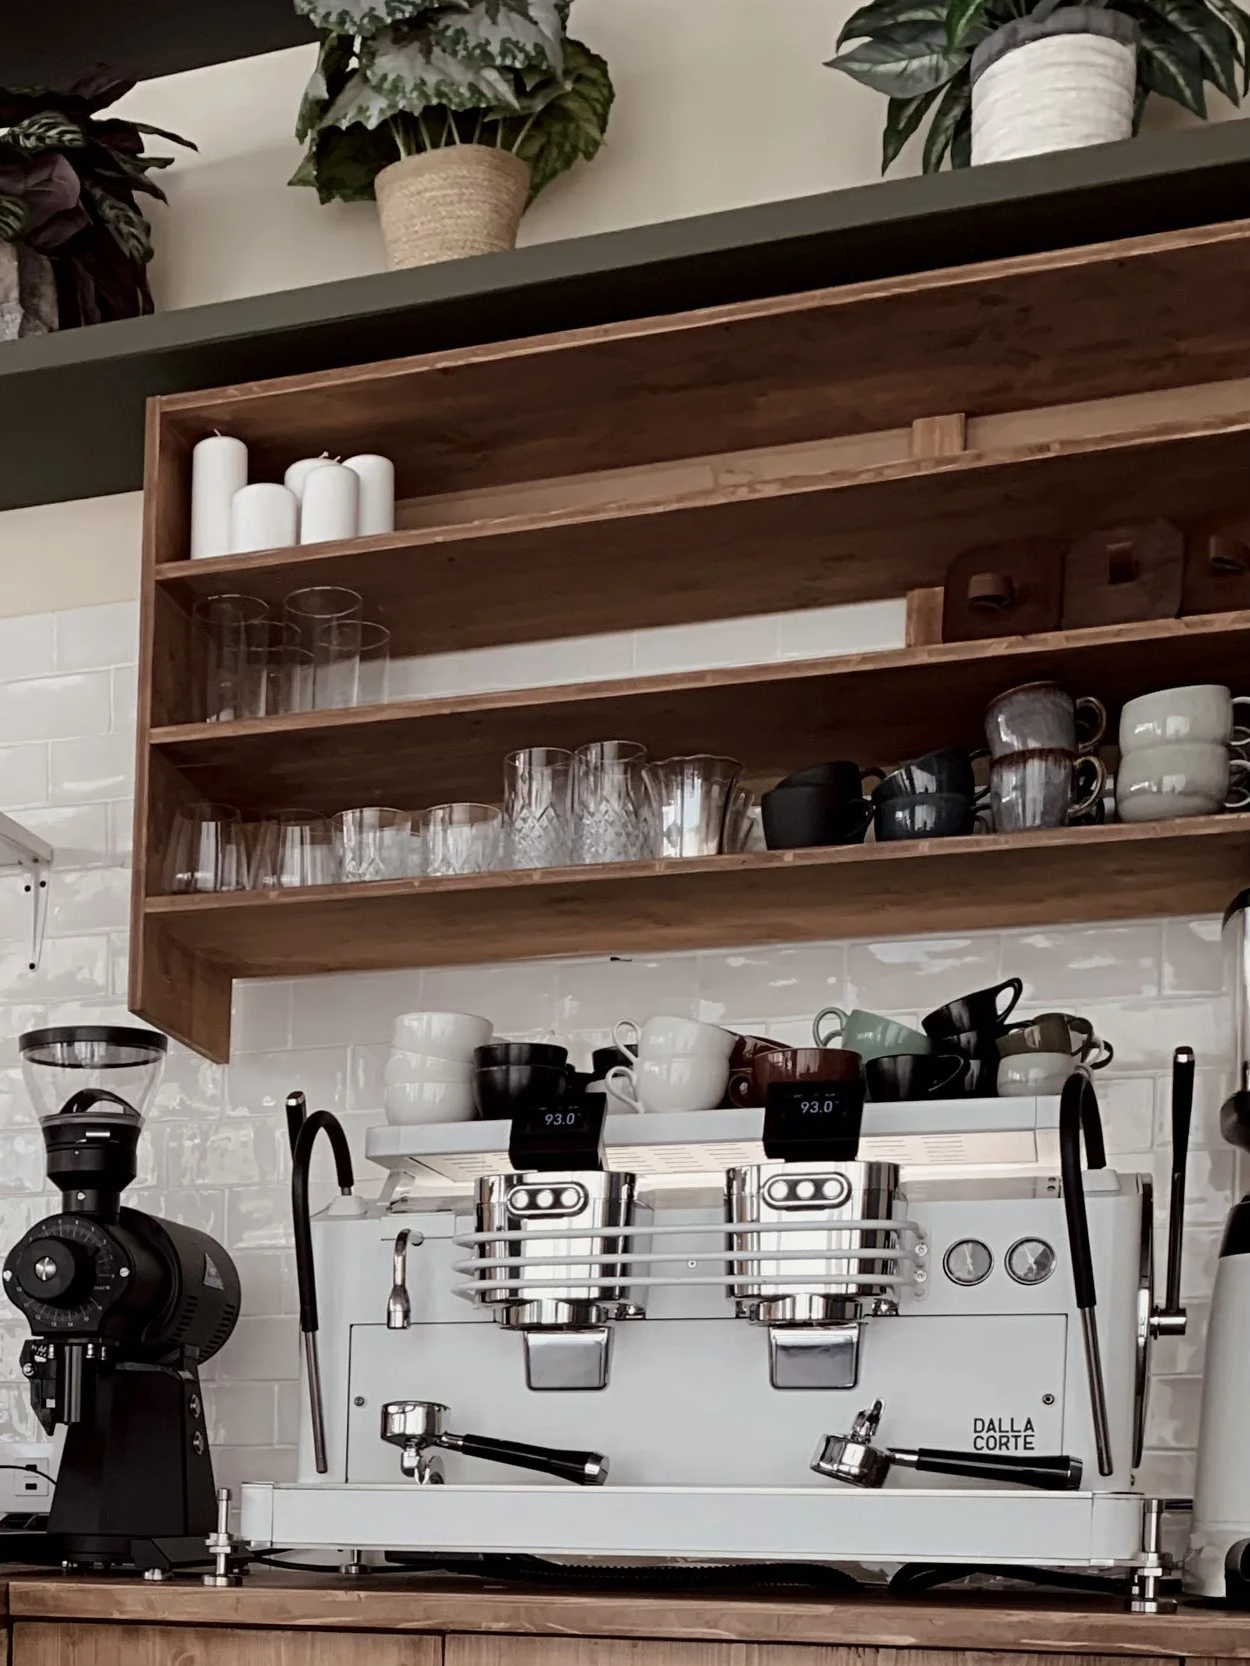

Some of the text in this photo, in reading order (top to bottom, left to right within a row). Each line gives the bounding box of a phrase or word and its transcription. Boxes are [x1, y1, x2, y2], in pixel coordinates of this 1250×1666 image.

[800, 1100, 833, 1114] 93.0
[544, 1111, 575, 1126] 93.0
[973, 1417, 1035, 1434] DALLA
[973, 1435, 1035, 1451] CORTE
